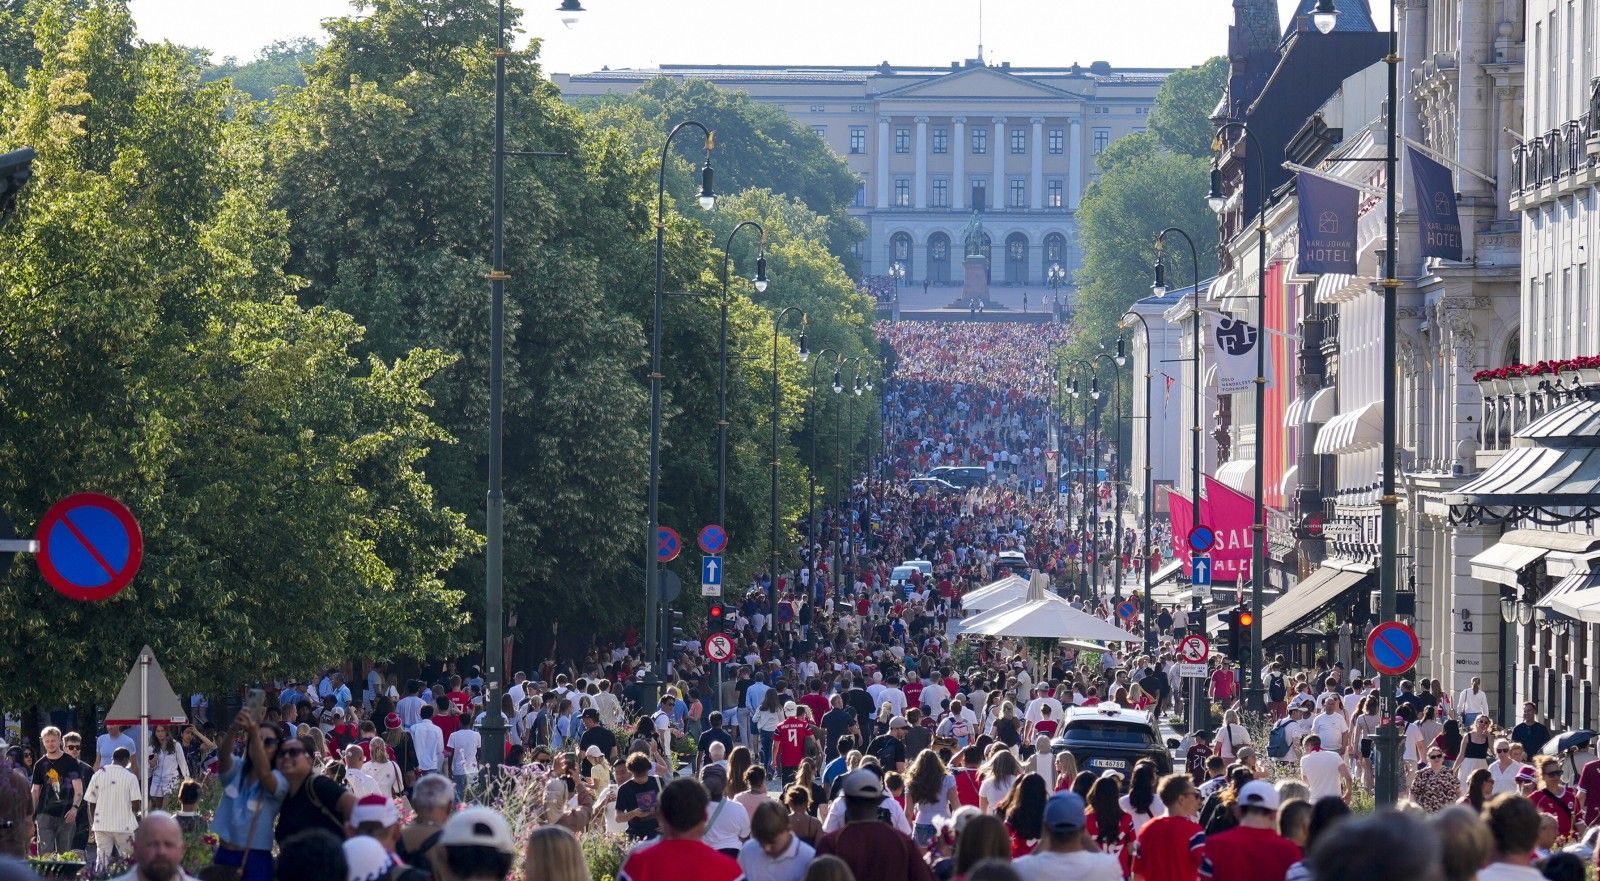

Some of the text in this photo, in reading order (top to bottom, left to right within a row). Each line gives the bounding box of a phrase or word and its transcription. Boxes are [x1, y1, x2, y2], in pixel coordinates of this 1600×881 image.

[1327, 240, 1350, 248] JOHAN
[1427, 231, 1461, 248] HOTEL
[1306, 249, 1350, 262] HOTEL
[1214, 528, 1254, 551] SAL
[1463, 621, 1473, 632] 33
[788, 728, 798, 747] 9
